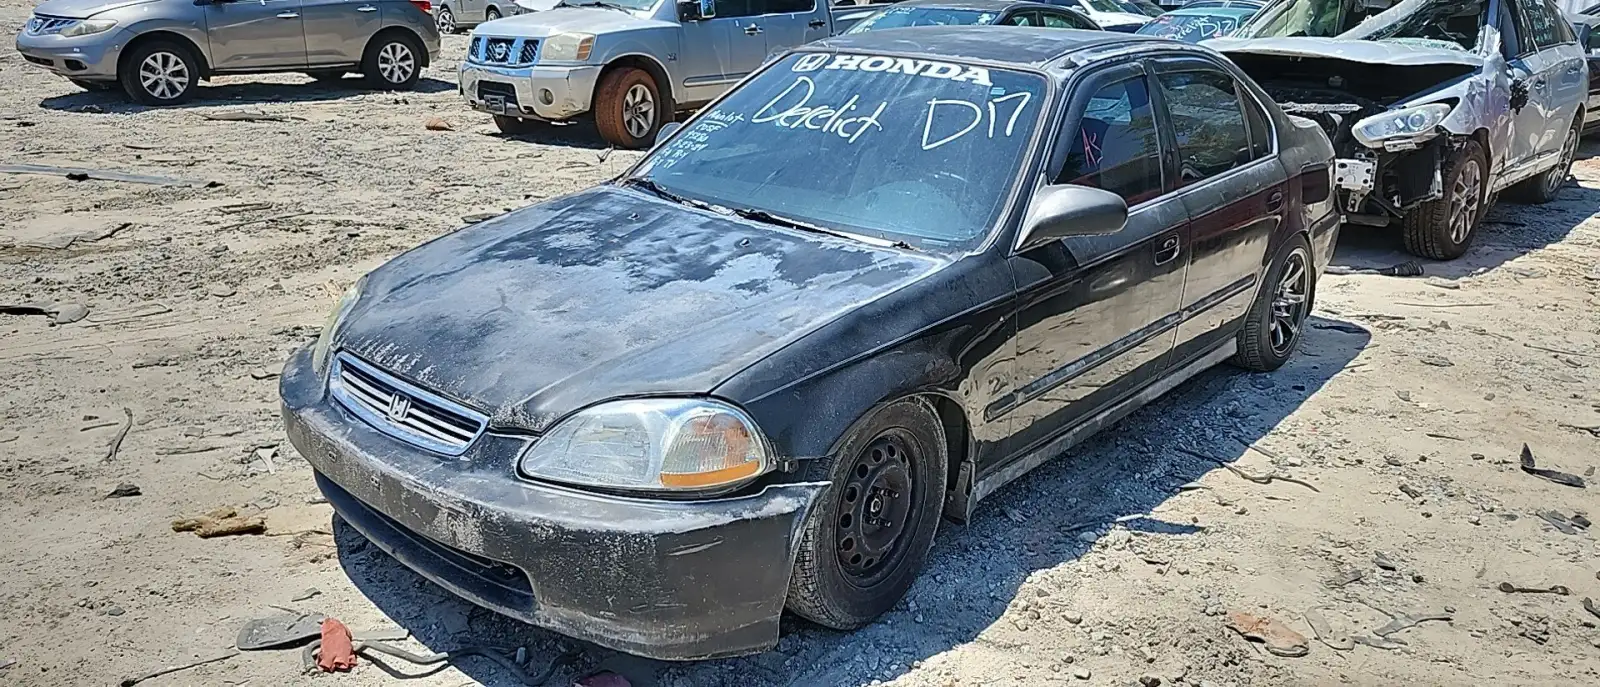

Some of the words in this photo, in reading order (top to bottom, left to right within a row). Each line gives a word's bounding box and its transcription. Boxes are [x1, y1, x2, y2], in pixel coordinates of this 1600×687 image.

[1200, 19, 1233, 38] D17
[824, 54, 994, 87] HONDA
[751, 75, 888, 144] Derelict
[921, 91, 1032, 150] D17
